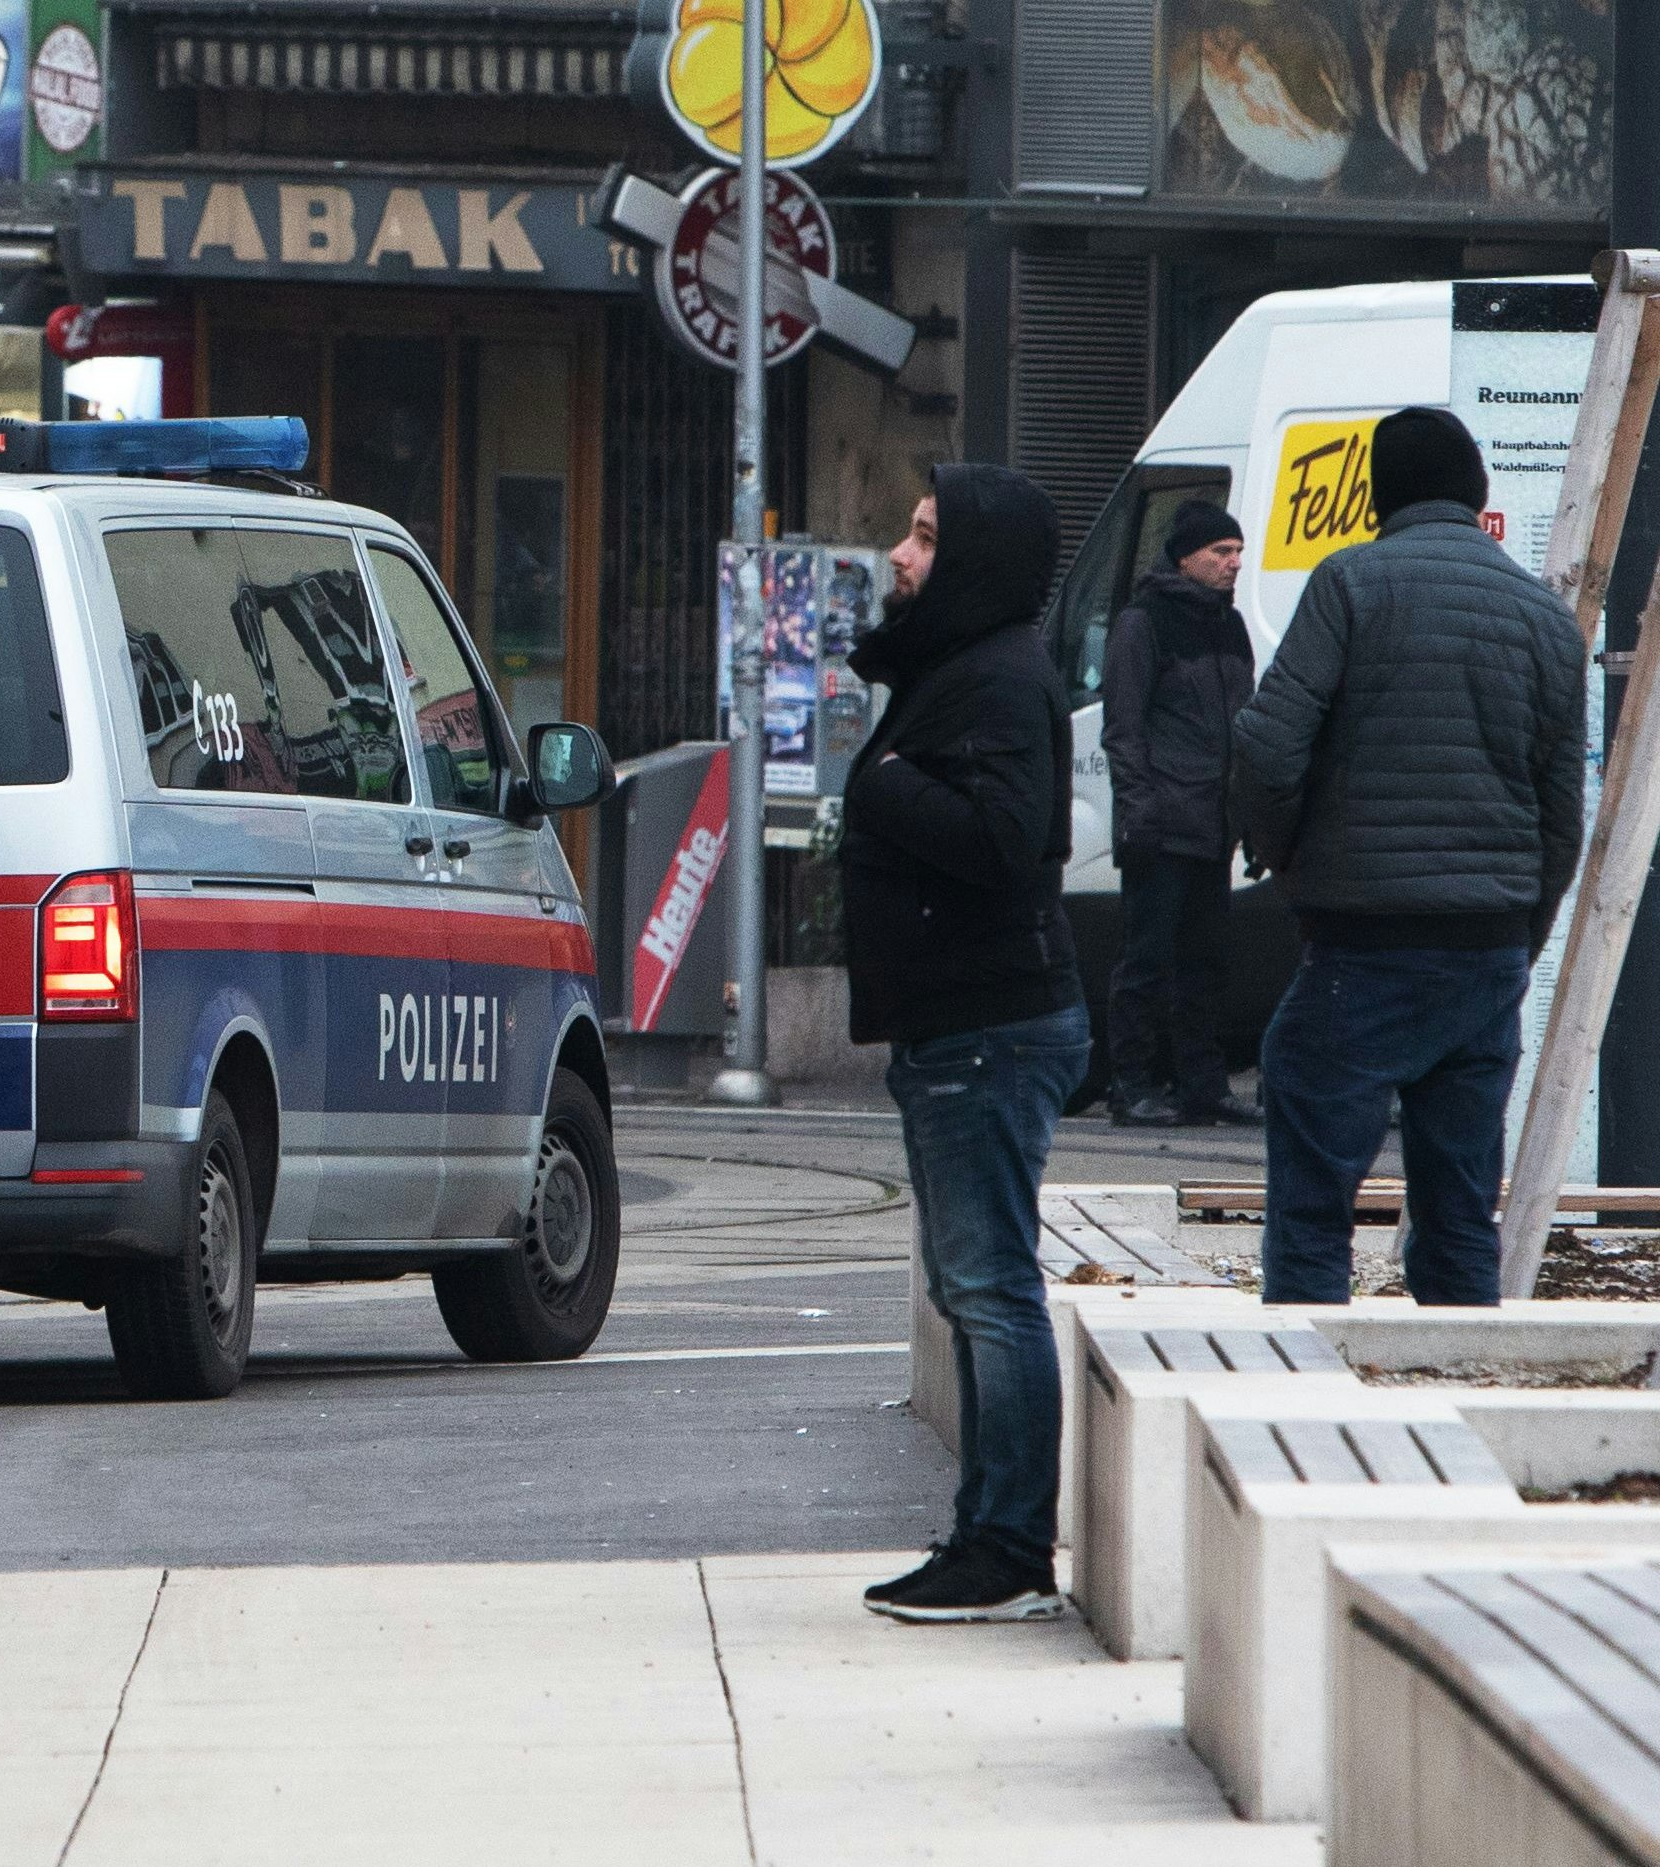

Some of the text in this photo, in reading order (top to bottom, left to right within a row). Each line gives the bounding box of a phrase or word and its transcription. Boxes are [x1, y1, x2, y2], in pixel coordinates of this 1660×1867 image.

[113, 180, 545, 273] TABAK
[674, 249, 791, 351] TRAFK
[1478, 386, 1583, 404] Reumann
[208, 692, 244, 762] 133
[642, 827, 720, 965] Heute
[378, 992, 499, 1083] POLIZEI
